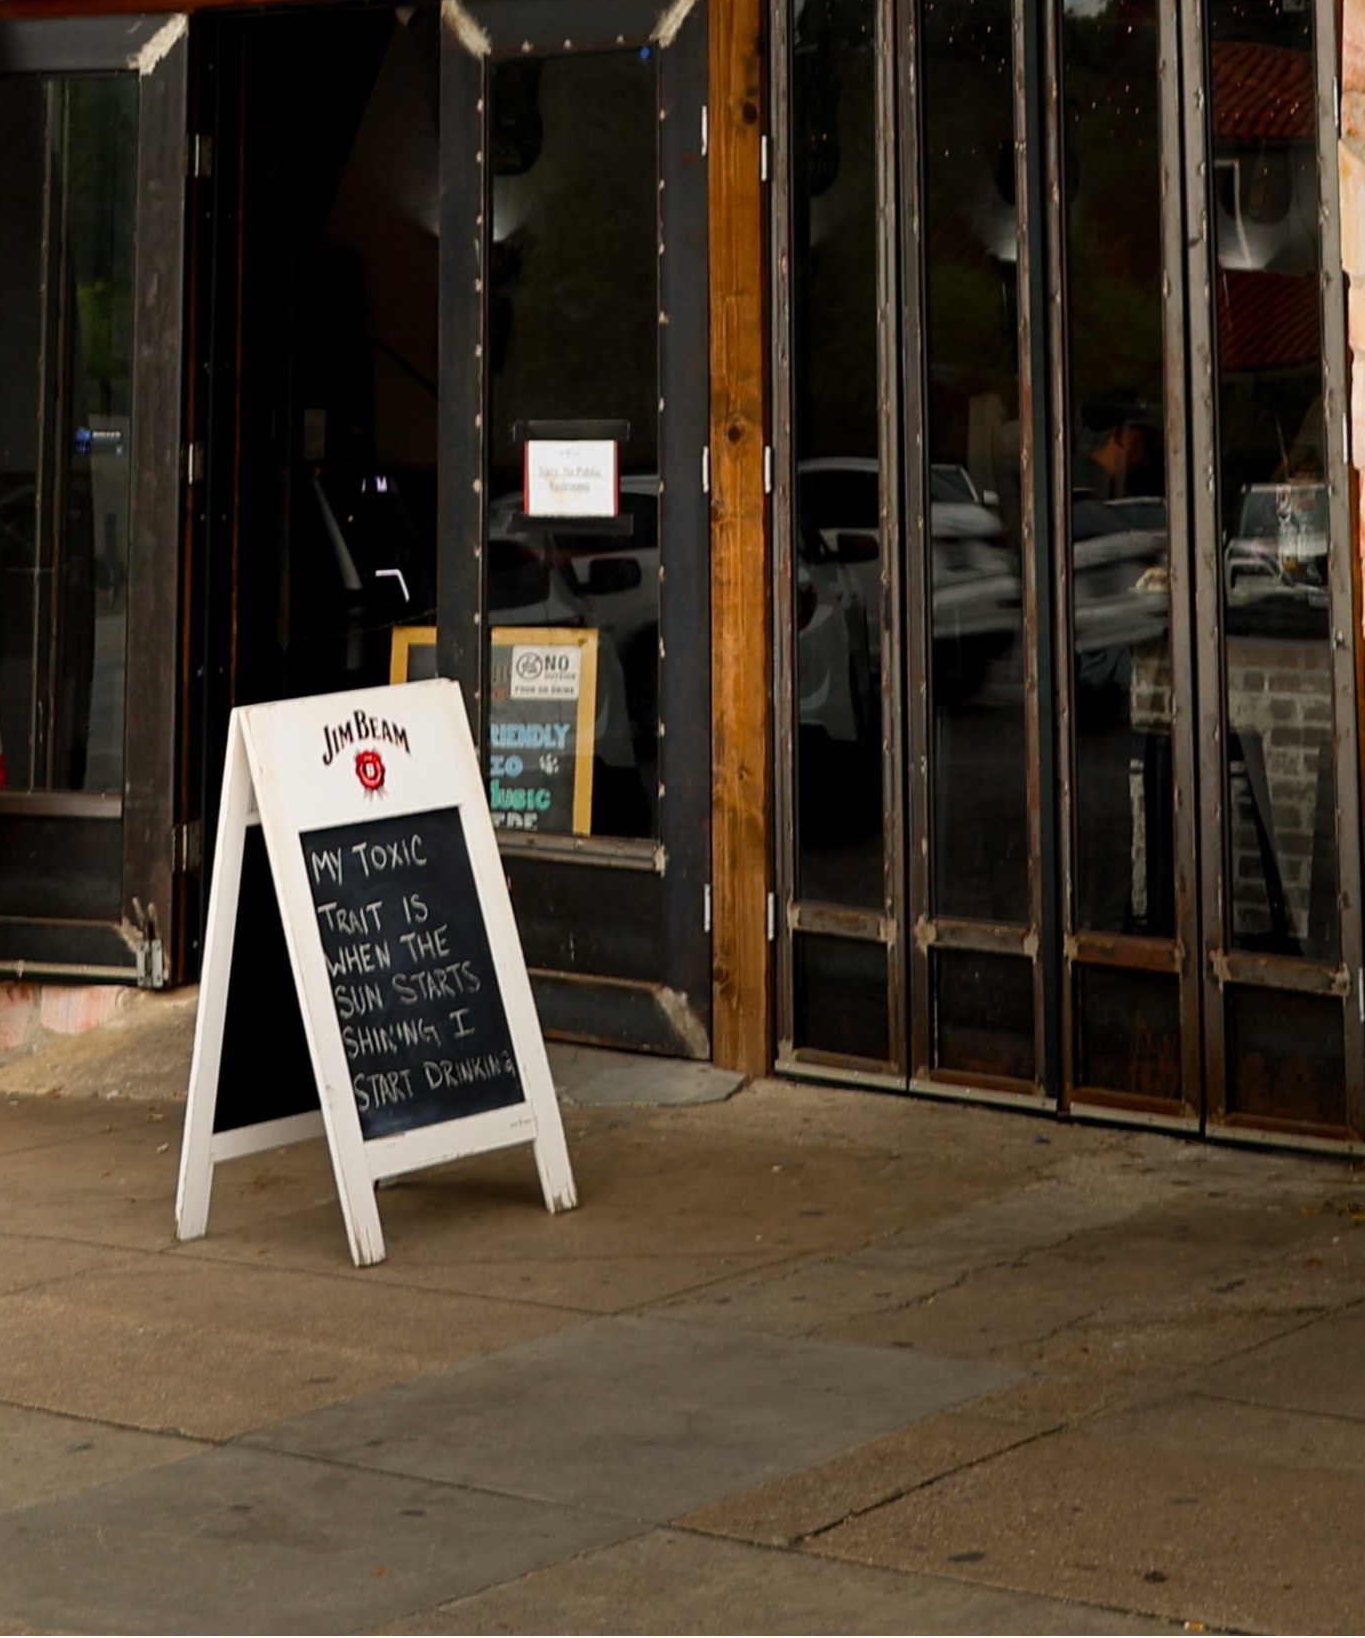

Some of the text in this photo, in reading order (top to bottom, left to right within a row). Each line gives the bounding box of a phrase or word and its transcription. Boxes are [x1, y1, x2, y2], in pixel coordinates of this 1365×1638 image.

[545, 654, 570, 672] NO
[323, 710, 411, 766] JIM BEAM
[311, 834, 427, 886] MY TOXIC
[317, 894, 429, 936] TRAIT IS
[326, 924, 451, 978] WHEN THE
[336, 960, 482, 1021] SUN STARTS
[449, 1008, 475, 1039] I
[354, 1049, 517, 1112] START DRINKING
